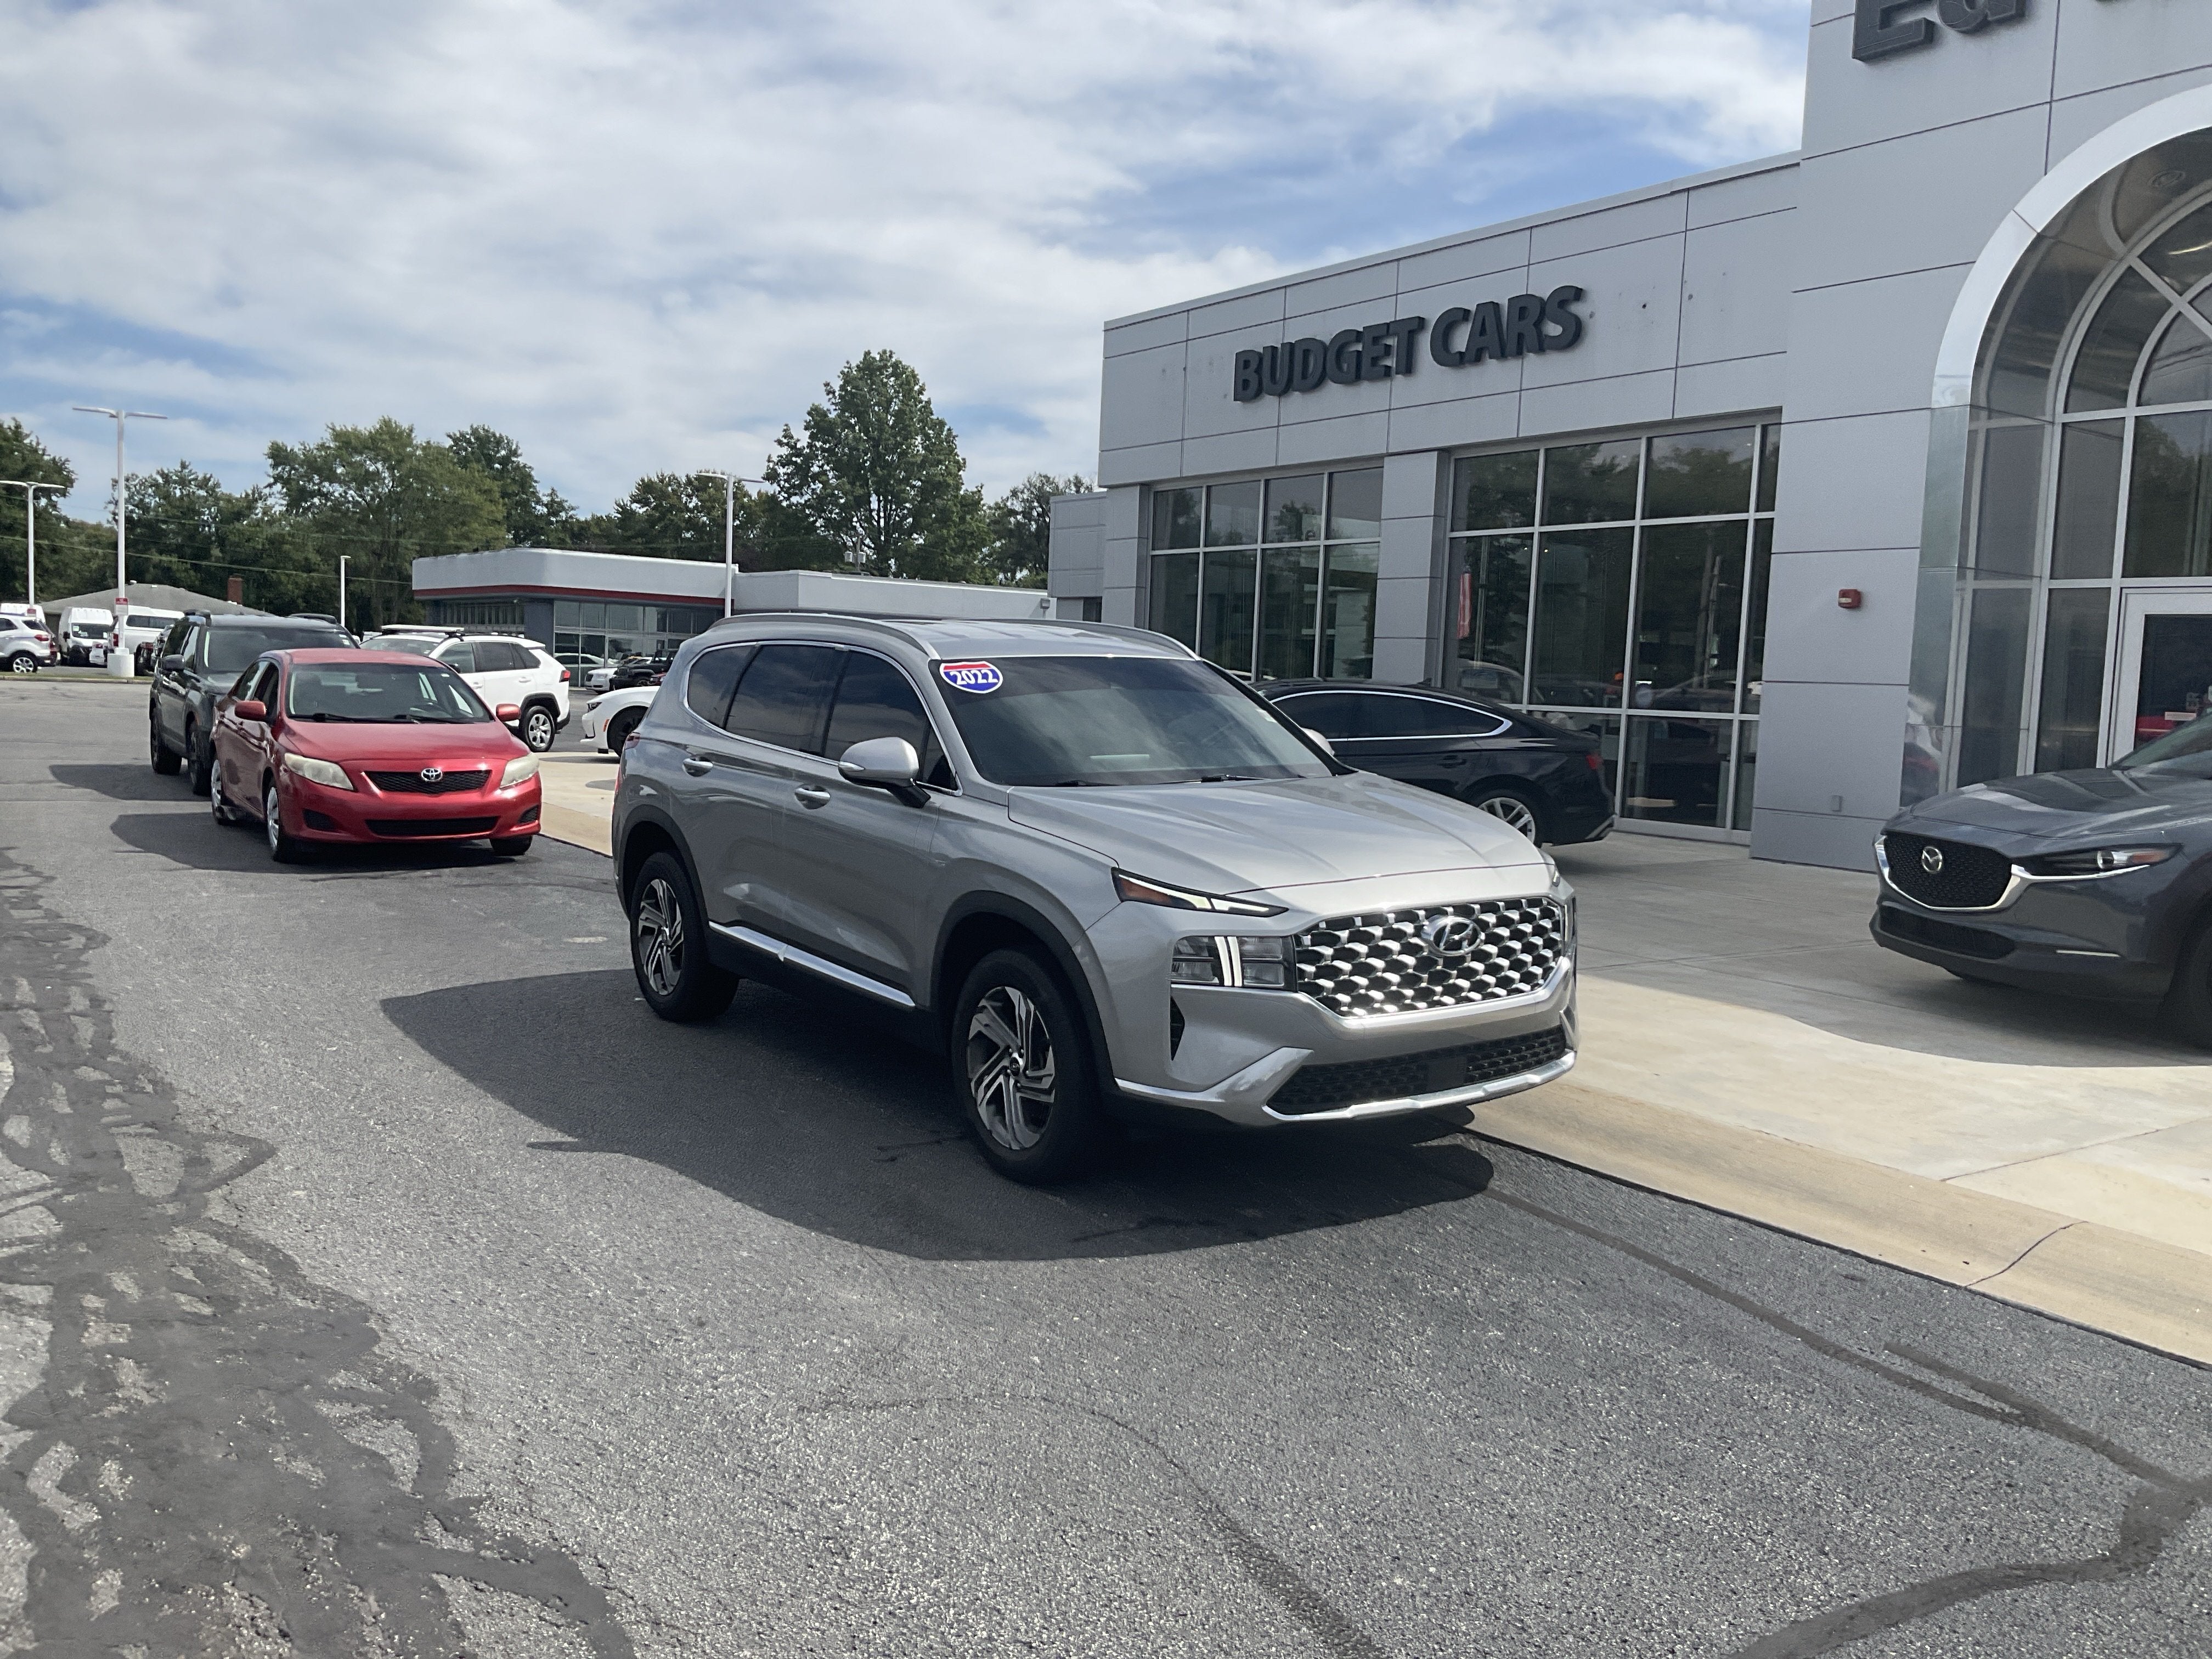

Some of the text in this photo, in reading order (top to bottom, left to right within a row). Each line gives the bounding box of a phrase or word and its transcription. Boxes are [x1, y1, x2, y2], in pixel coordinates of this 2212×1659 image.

[1233, 285, 1583, 402] BUDGET CARS
[950, 669, 998, 685] 2022
